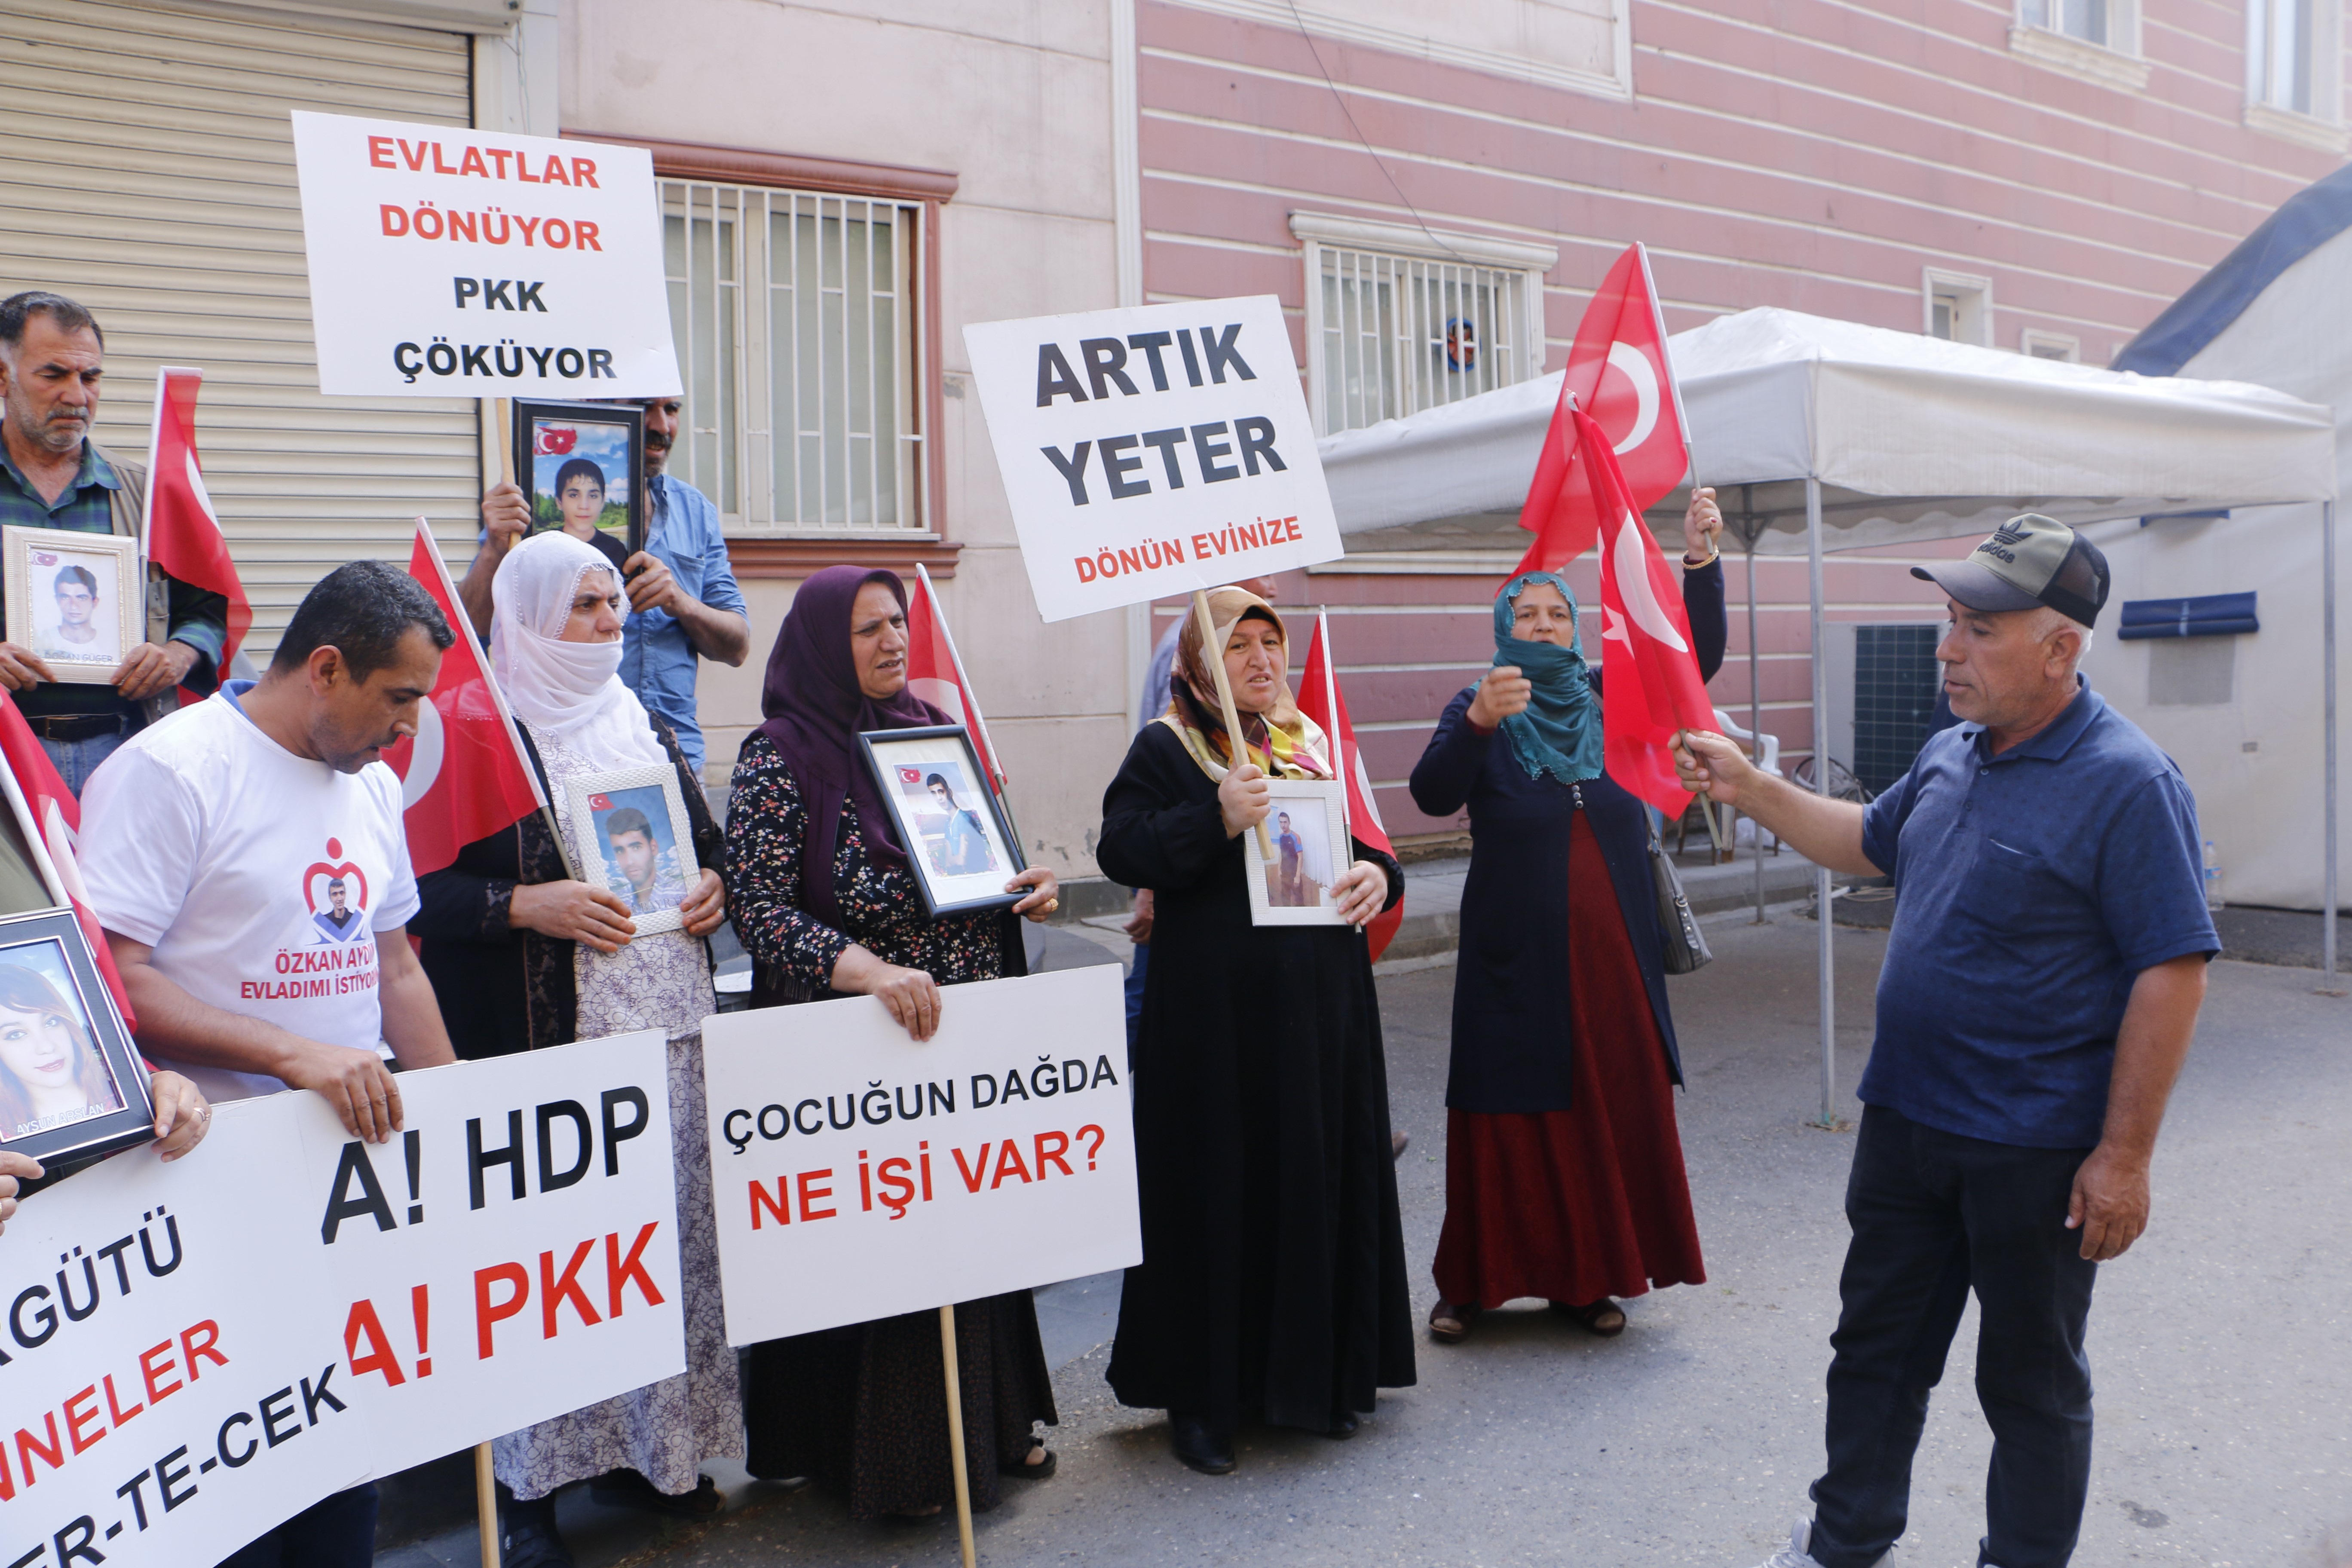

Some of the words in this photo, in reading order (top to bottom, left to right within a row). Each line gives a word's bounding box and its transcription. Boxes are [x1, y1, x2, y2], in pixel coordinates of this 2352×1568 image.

[367, 135, 600, 189] EVLATLAR
[379, 200, 603, 251] DÖNÜYOR
[453, 277, 548, 312] PKK
[393, 336, 617, 383] ÇÖKÜYOR
[1036, 323, 1257, 407] ARTIK
[1040, 416, 1288, 506] YETER
[1074, 537, 1185, 583] DÖNÜN
[1191, 516, 1303, 560] EVİNİZE
[1977, 542, 2015, 564] adidas
[241, 978, 330, 999] EVLADIMI
[275, 948, 342, 974] ÖZKAN
[17, 1115, 56, 1134] AYSUN
[59, 1102, 105, 1124] ARSLAN
[723, 1079, 955, 1155] ÇOCUĞUN
[971, 1054, 1118, 1109] DAĞDA
[466, 1085, 649, 1211] HDP
[747, 1168, 837, 1231] NE
[858, 1140, 933, 1221] İŞİ
[951, 1124, 1106, 1194] VAR?
[0, 1205, 183, 1366] GÜTÜ
[473, 1220, 666, 1360] PKK
